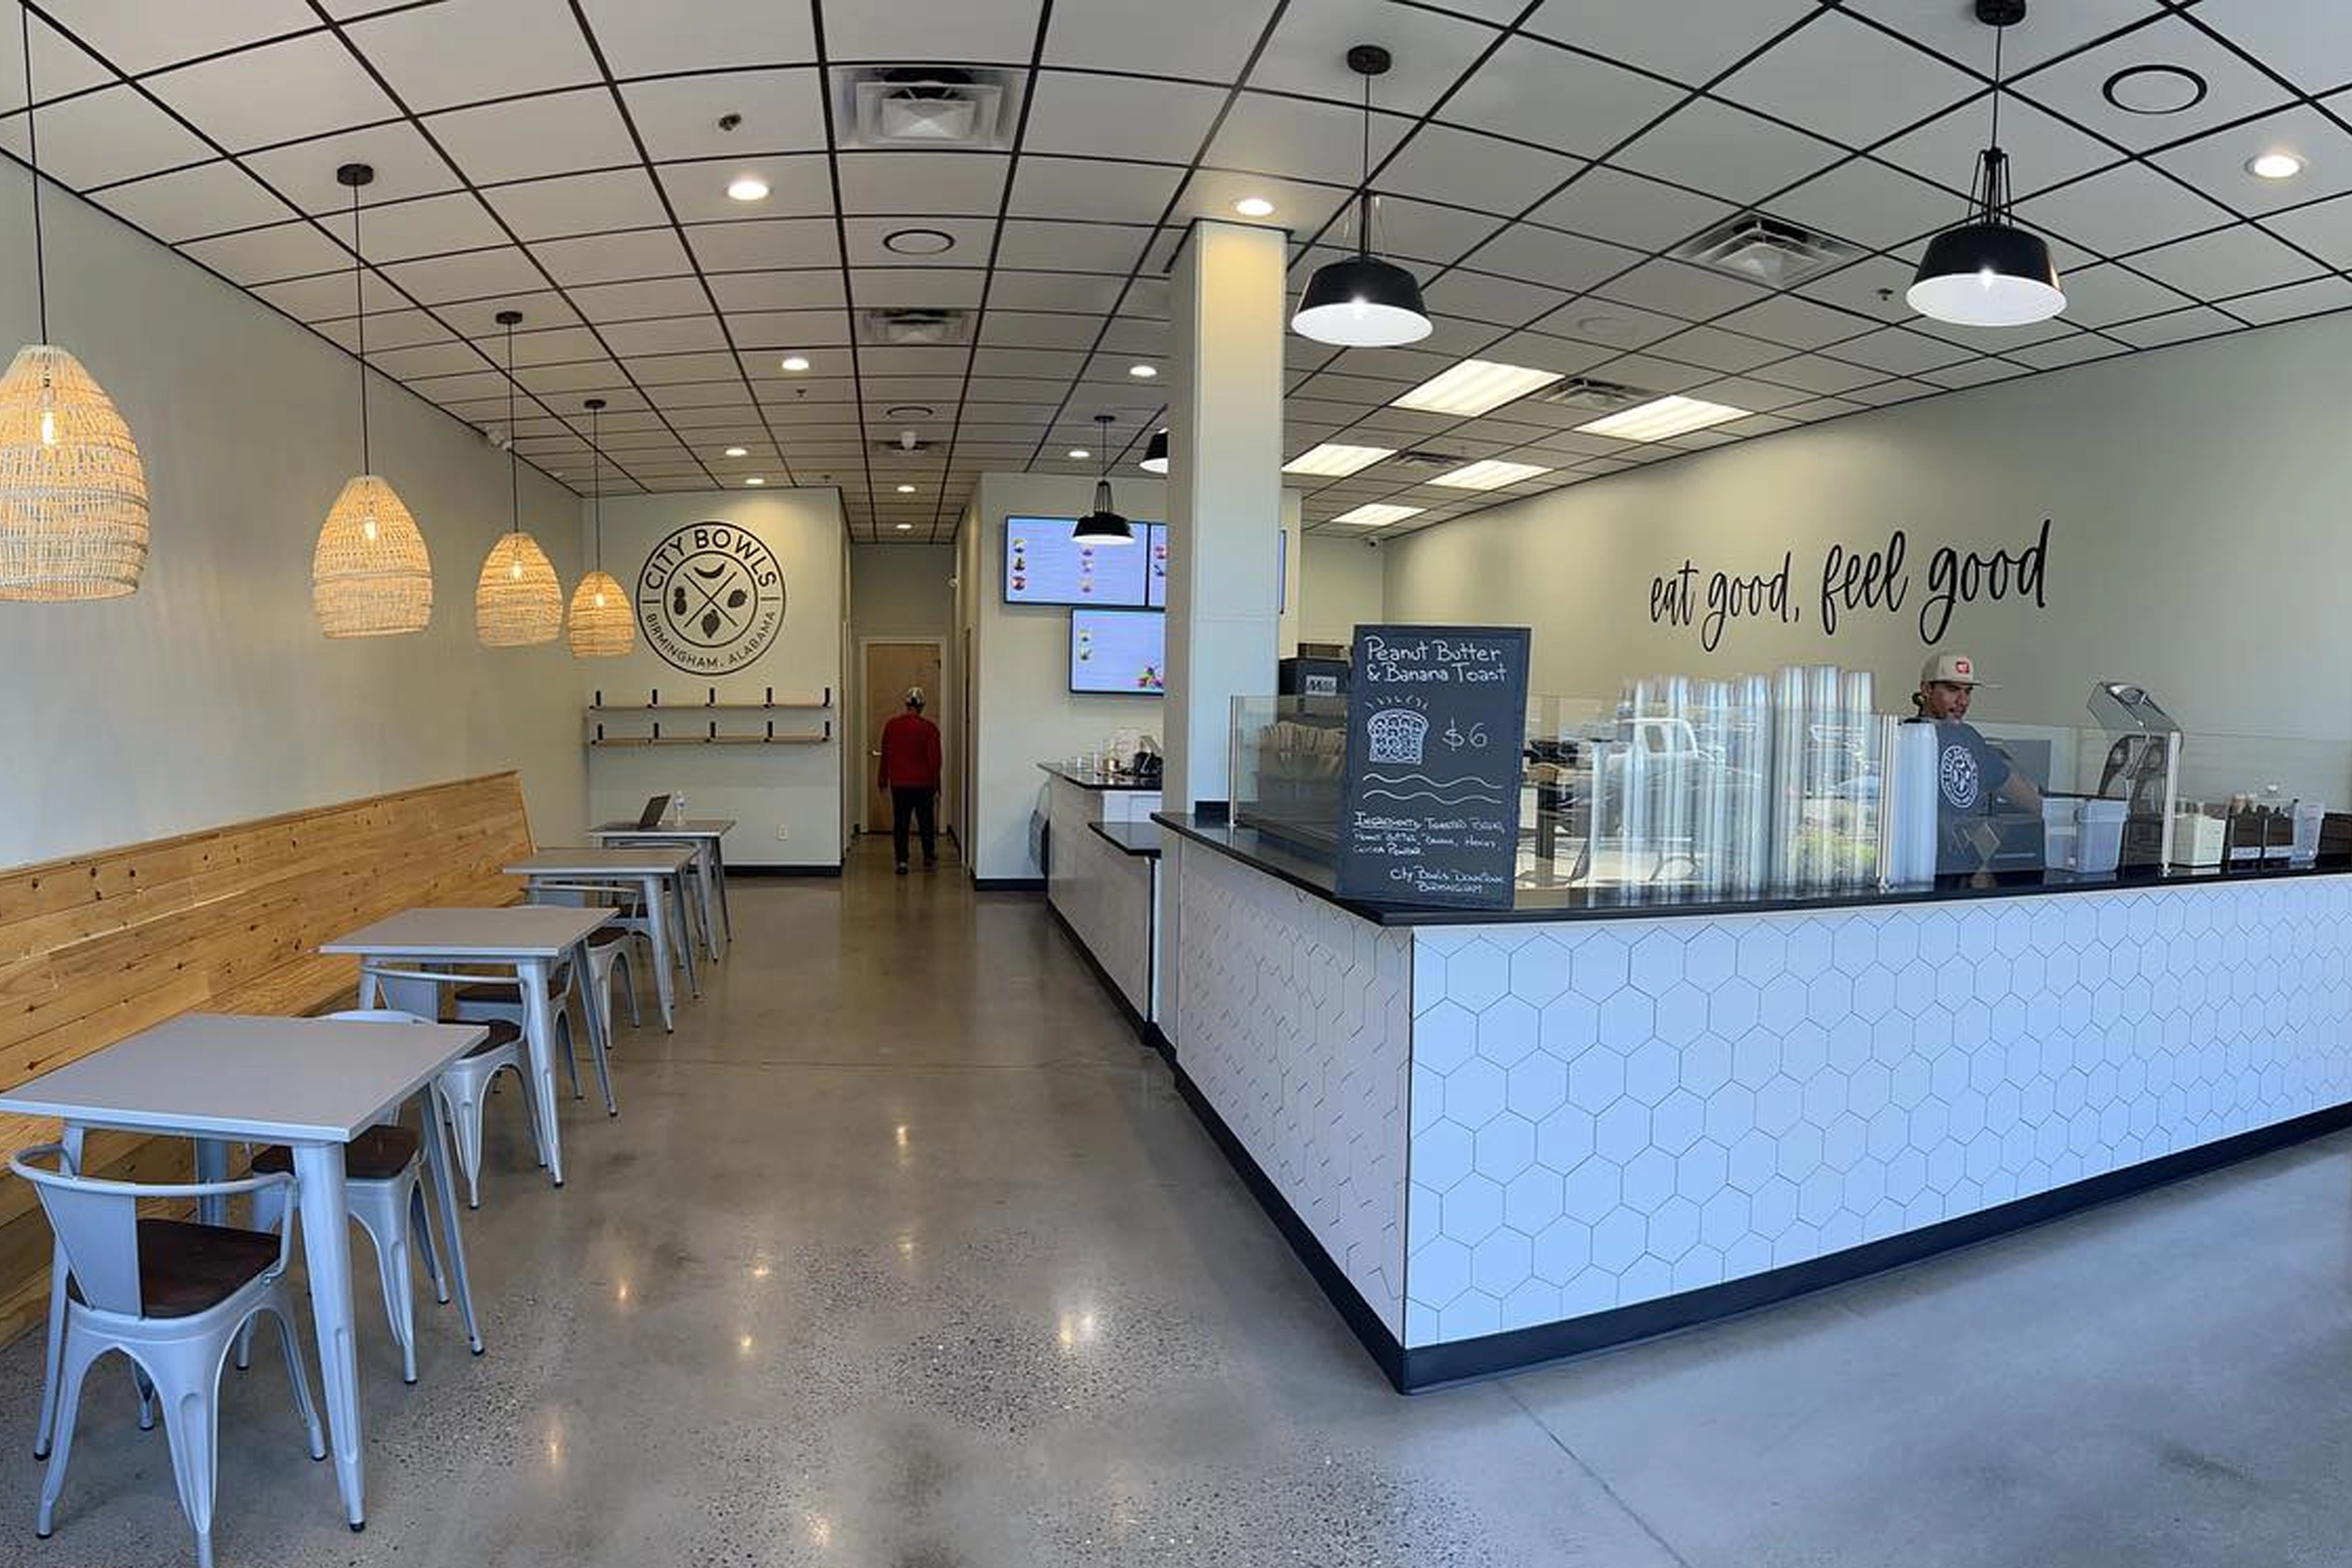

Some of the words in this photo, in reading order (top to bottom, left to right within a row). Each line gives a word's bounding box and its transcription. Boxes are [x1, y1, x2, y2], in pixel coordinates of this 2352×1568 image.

[645, 535, 686, 590] CITY
[694, 528, 777, 588] BOWLS
[1651, 559, 1699, 626] eat
[1701, 551, 1800, 653] good,
[1821, 530, 1909, 636] feel
[1919, 518, 2051, 646] good
[727, 610, 776, 665] ALABAMA
[1364, 635, 1429, 661] Peanut
[1431, 640, 1502, 661] Butter
[1367, 664, 1380, 682] &
[1381, 661, 1449, 683] Banana
[1451, 661, 1508, 683] Toast
[1442, 717, 1488, 752] $6
